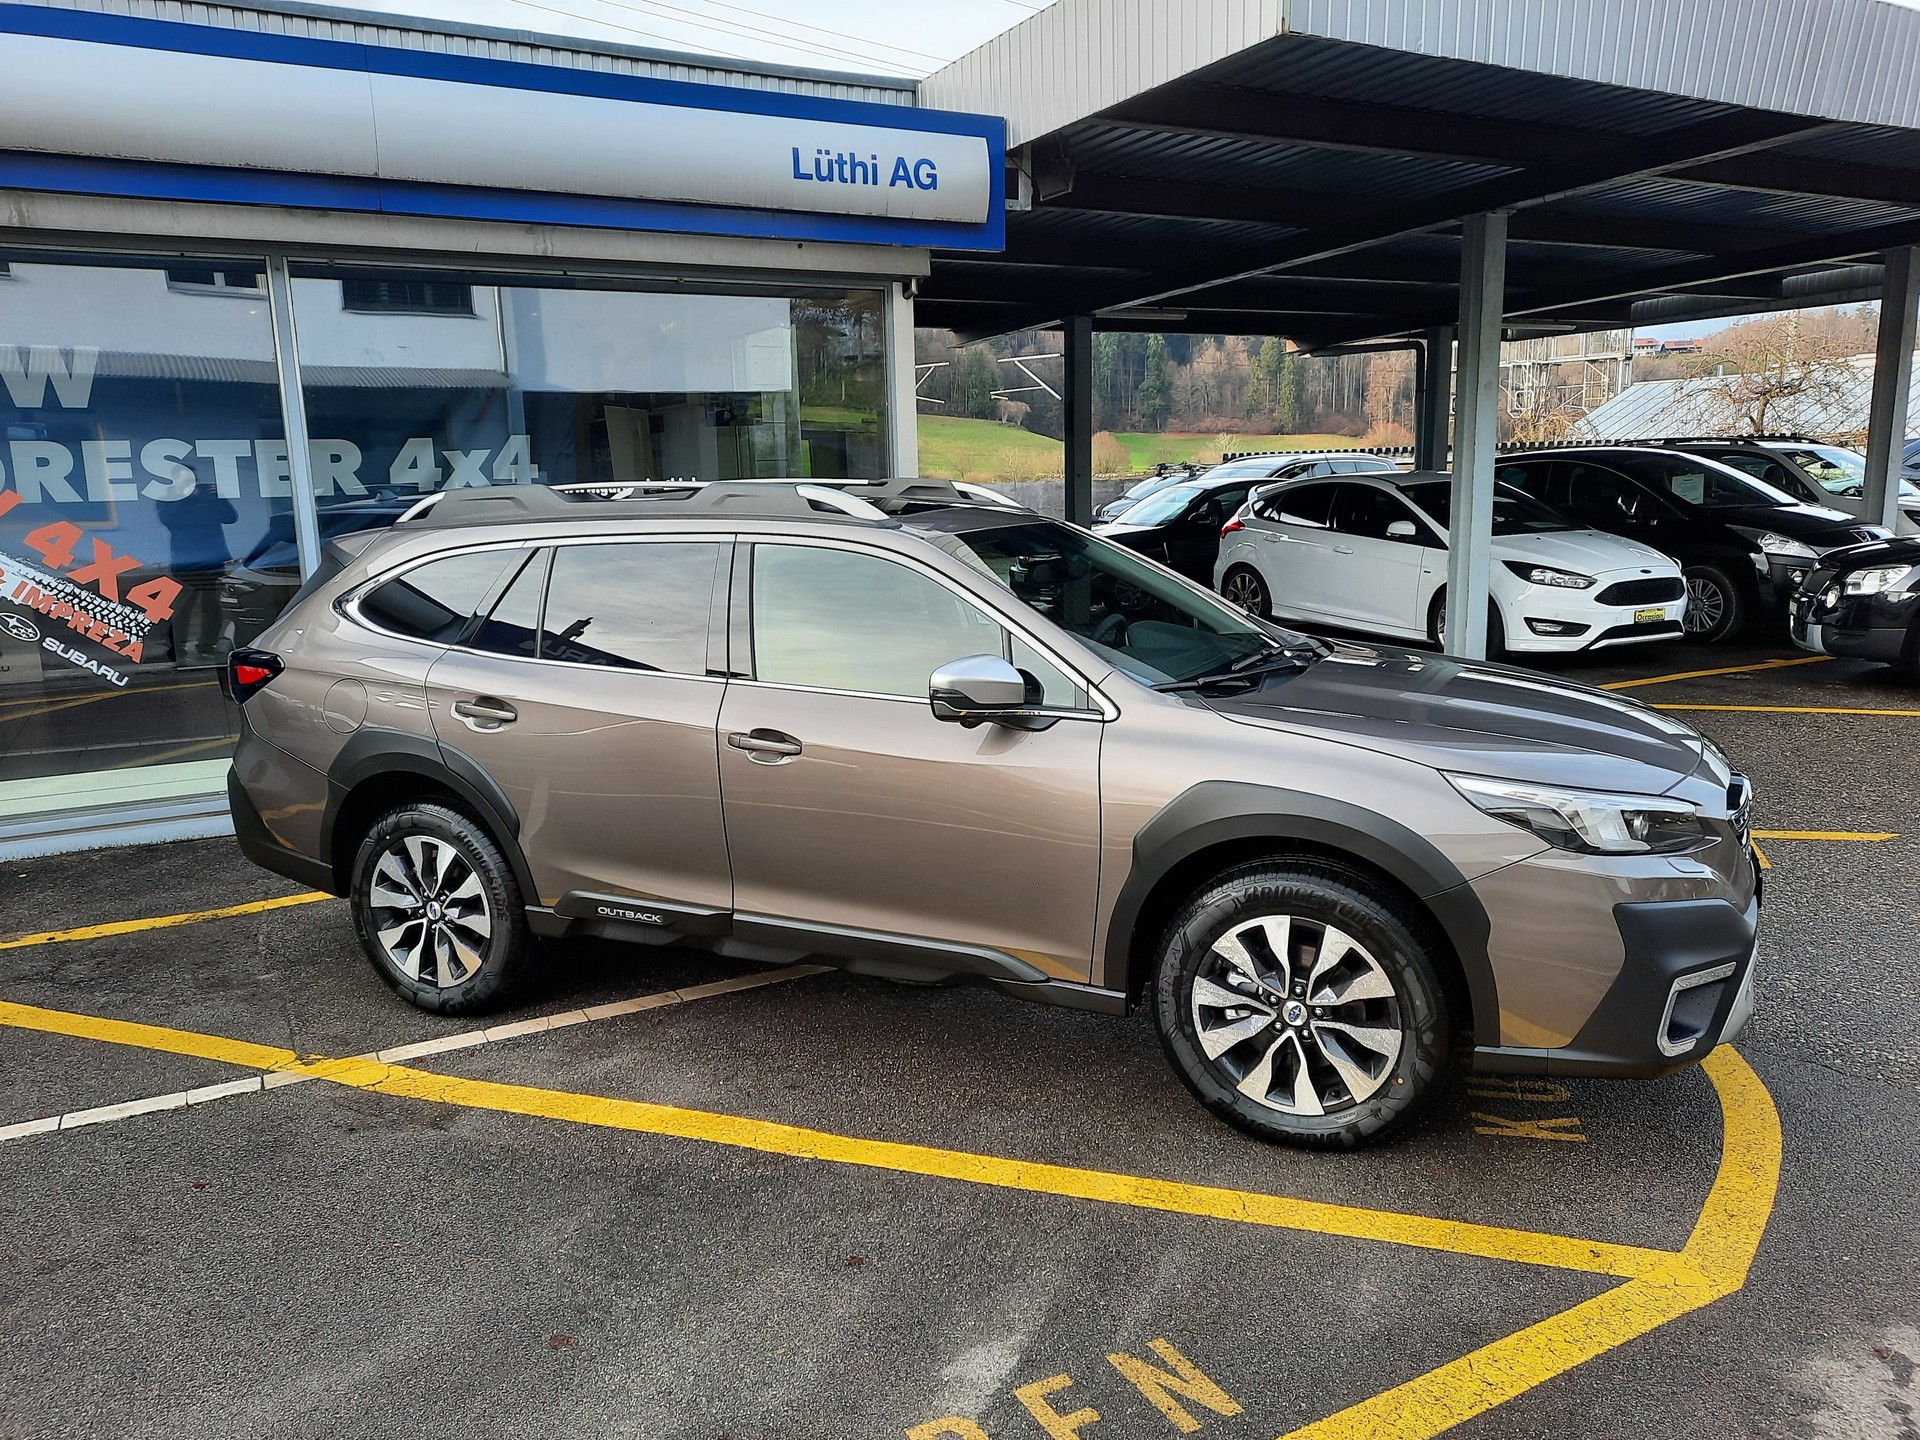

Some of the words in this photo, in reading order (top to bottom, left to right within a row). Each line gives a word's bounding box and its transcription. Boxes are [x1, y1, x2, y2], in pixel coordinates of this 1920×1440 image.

[791, 147, 878, 186] Lüthi
[889, 157, 938, 190] AG
[0, 438, 369, 504] RESTER
[389, 434, 539, 492] 4x4
[23, 520, 183, 624] 4X4
[11, 580, 144, 663] IMPREZA
[42, 637, 130, 687] SUBARU
[597, 906, 661, 923] OUTBACK
